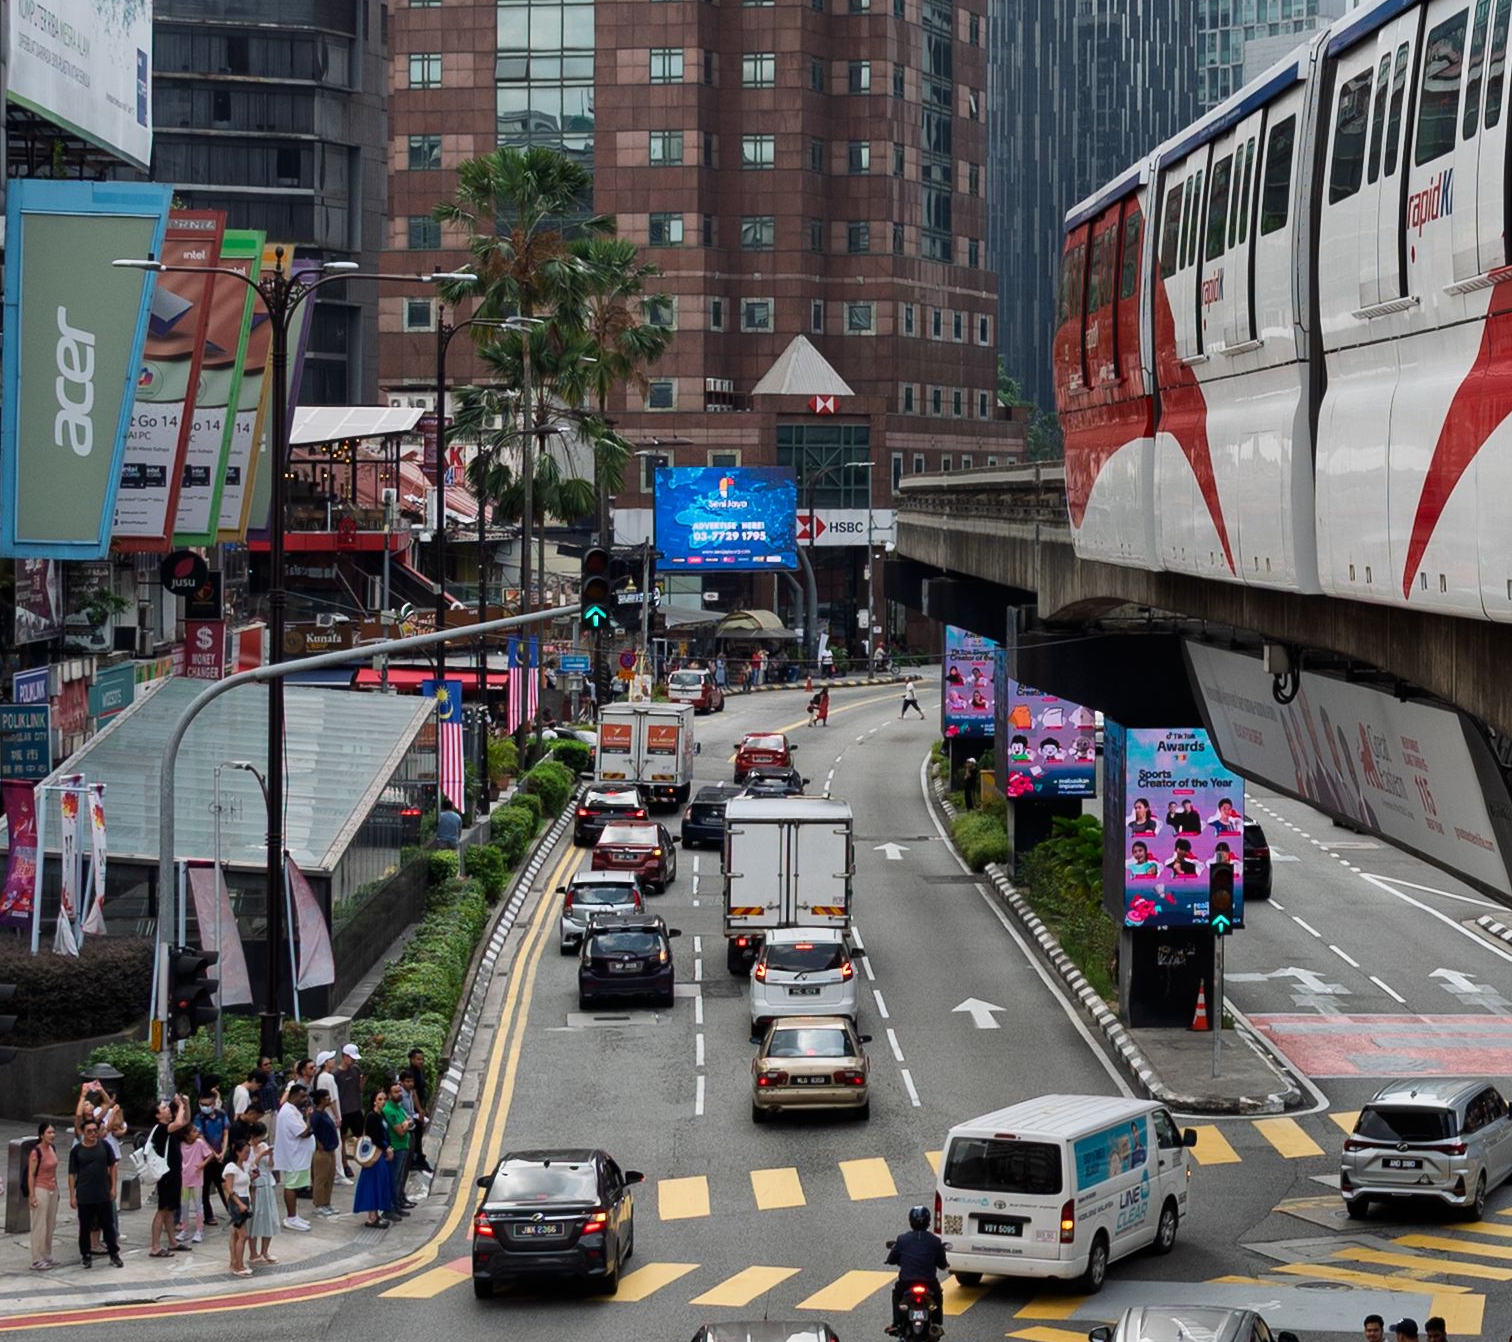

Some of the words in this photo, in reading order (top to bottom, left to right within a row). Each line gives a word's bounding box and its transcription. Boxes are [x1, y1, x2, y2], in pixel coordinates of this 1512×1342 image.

[54, 305, 96, 458] acer
[138, 414, 157, 428] Go
[161, 415, 178, 428] 14
[205, 419, 220, 431] 14
[236, 423, 250, 434] 14
[139, 431, 151, 440] PC
[829, 521, 864, 533] HSBC
[693, 531, 739, 541] 03-7729
[741, 531, 766, 541] 1795
[306, 631, 342, 644] Kunafa
[191, 653, 216, 665] MONEY
[187, 666, 220, 679] CHANGER
[1157, 741, 1205, 752] Awards
[1139, 769, 1172, 780] Sports
[1138, 778, 1177, 788] Creator
[1178, 778, 1190, 788] of
[1191, 778, 1208, 788] the
[1210, 778, 1233, 788] Year
[1119, 1185, 1140, 1210] LINE
[1117, 1201, 1148, 1230] CLEAR
[998, 1221, 1016, 1234] 5095
